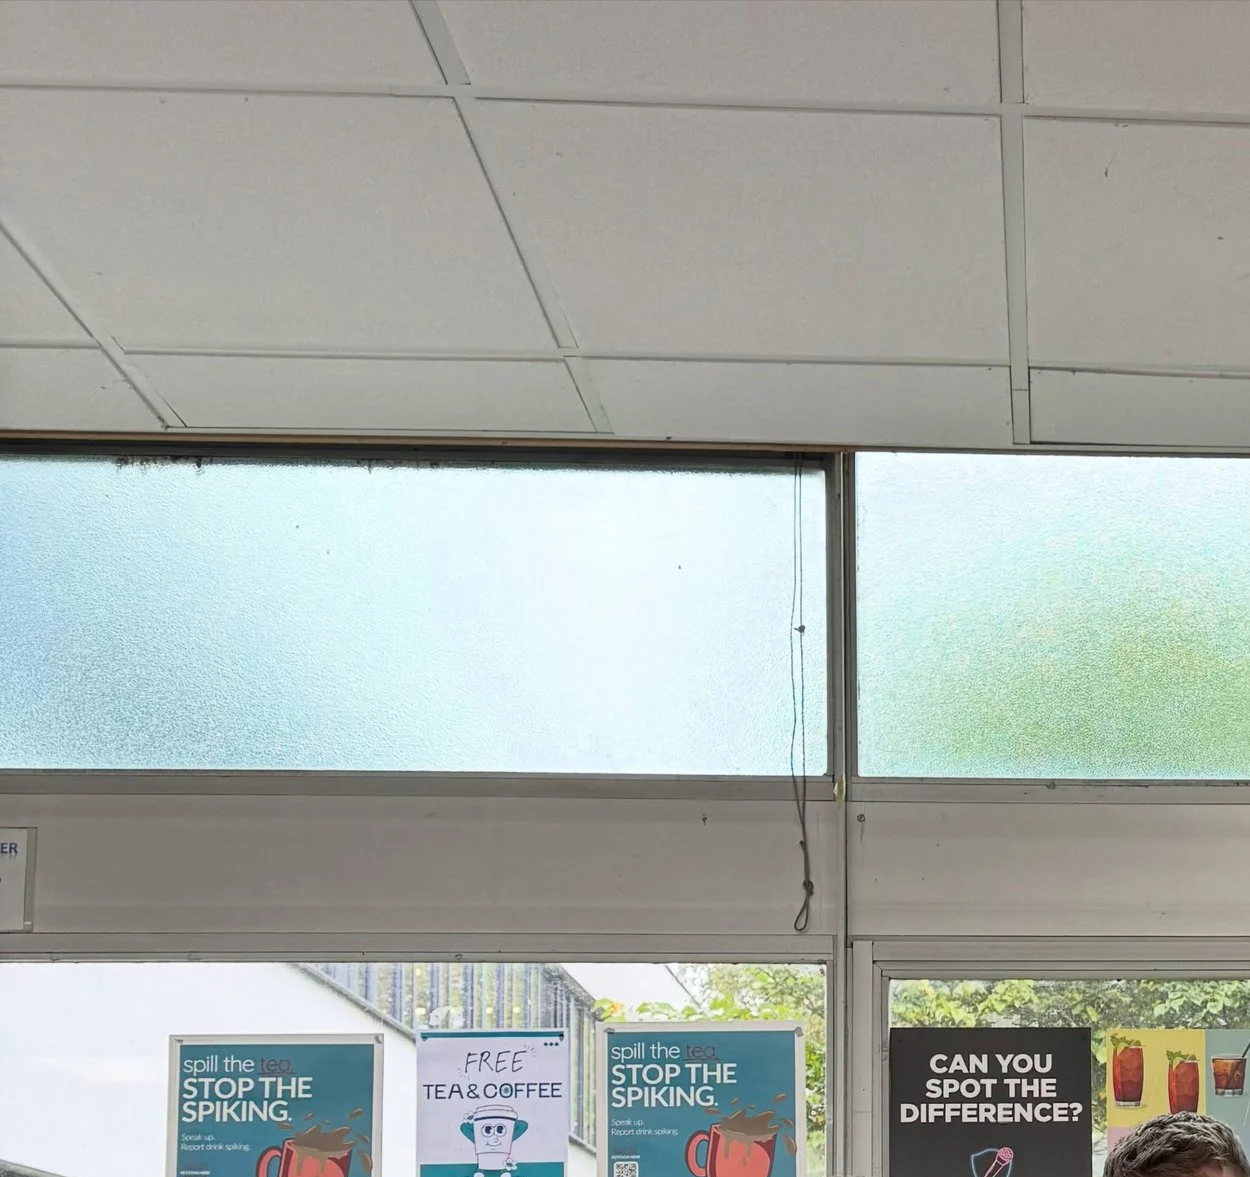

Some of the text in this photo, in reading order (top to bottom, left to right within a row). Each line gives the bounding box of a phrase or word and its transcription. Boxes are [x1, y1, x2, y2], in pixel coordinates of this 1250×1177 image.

[183, 1055, 254, 1076] spill the
[465, 1051, 528, 1073] FREE
[930, 1054, 1052, 1073] CAN YOU
[611, 1063, 737, 1085] STOP THE
[183, 1077, 312, 1099] STOP THE
[423, 1083, 562, 1099] TEA & COFFEE
[611, 1086, 718, 1107] SPIKING.
[926, 1079, 1057, 1098] SPOT THE
[182, 1101, 292, 1122] SPIKING.
[900, 1103, 1083, 1122] DIFFERENCE?
